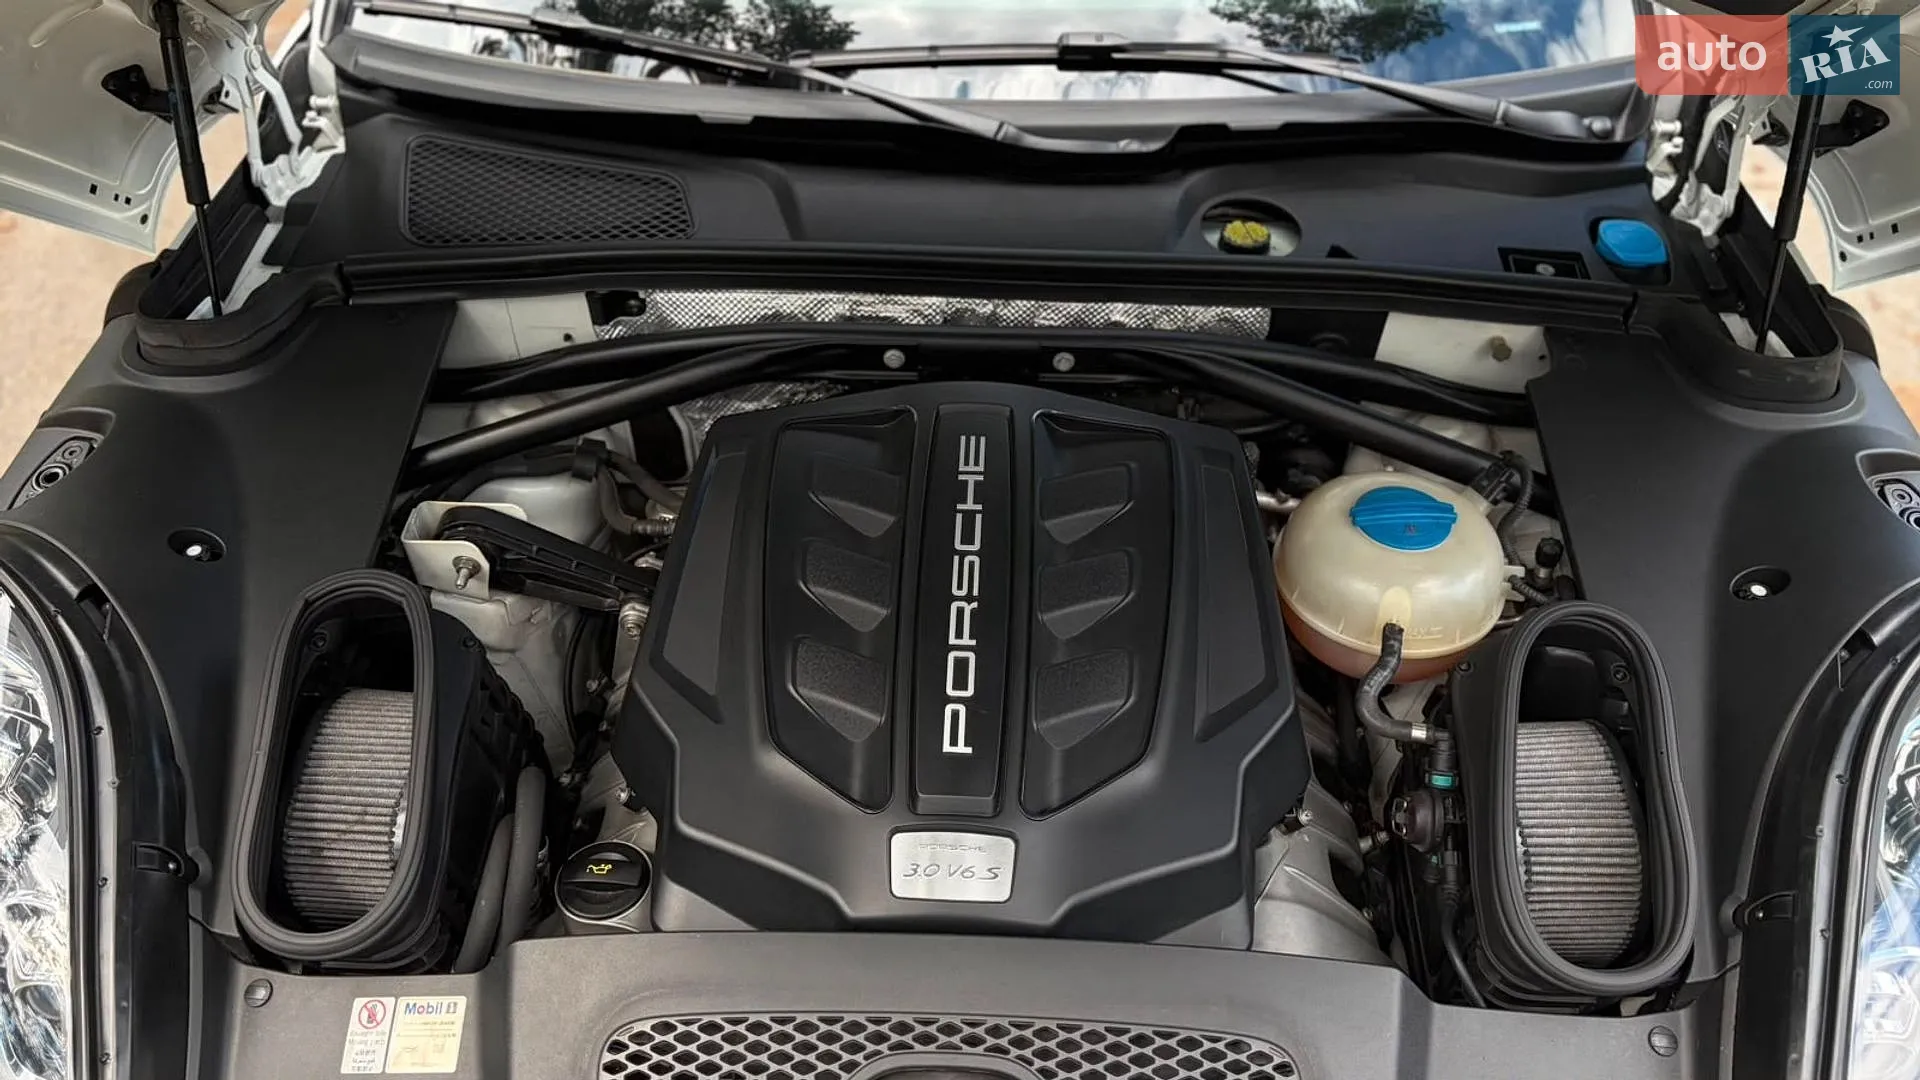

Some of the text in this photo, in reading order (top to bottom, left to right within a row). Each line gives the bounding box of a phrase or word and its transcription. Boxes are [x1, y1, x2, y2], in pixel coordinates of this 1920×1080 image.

[942, 435, 987, 754] PORSCHE
[919, 843, 987, 853] PORSCHE
[903, 863, 1001, 880] 3.0 V6 S
[404, 1002, 442, 1015] Mobil
